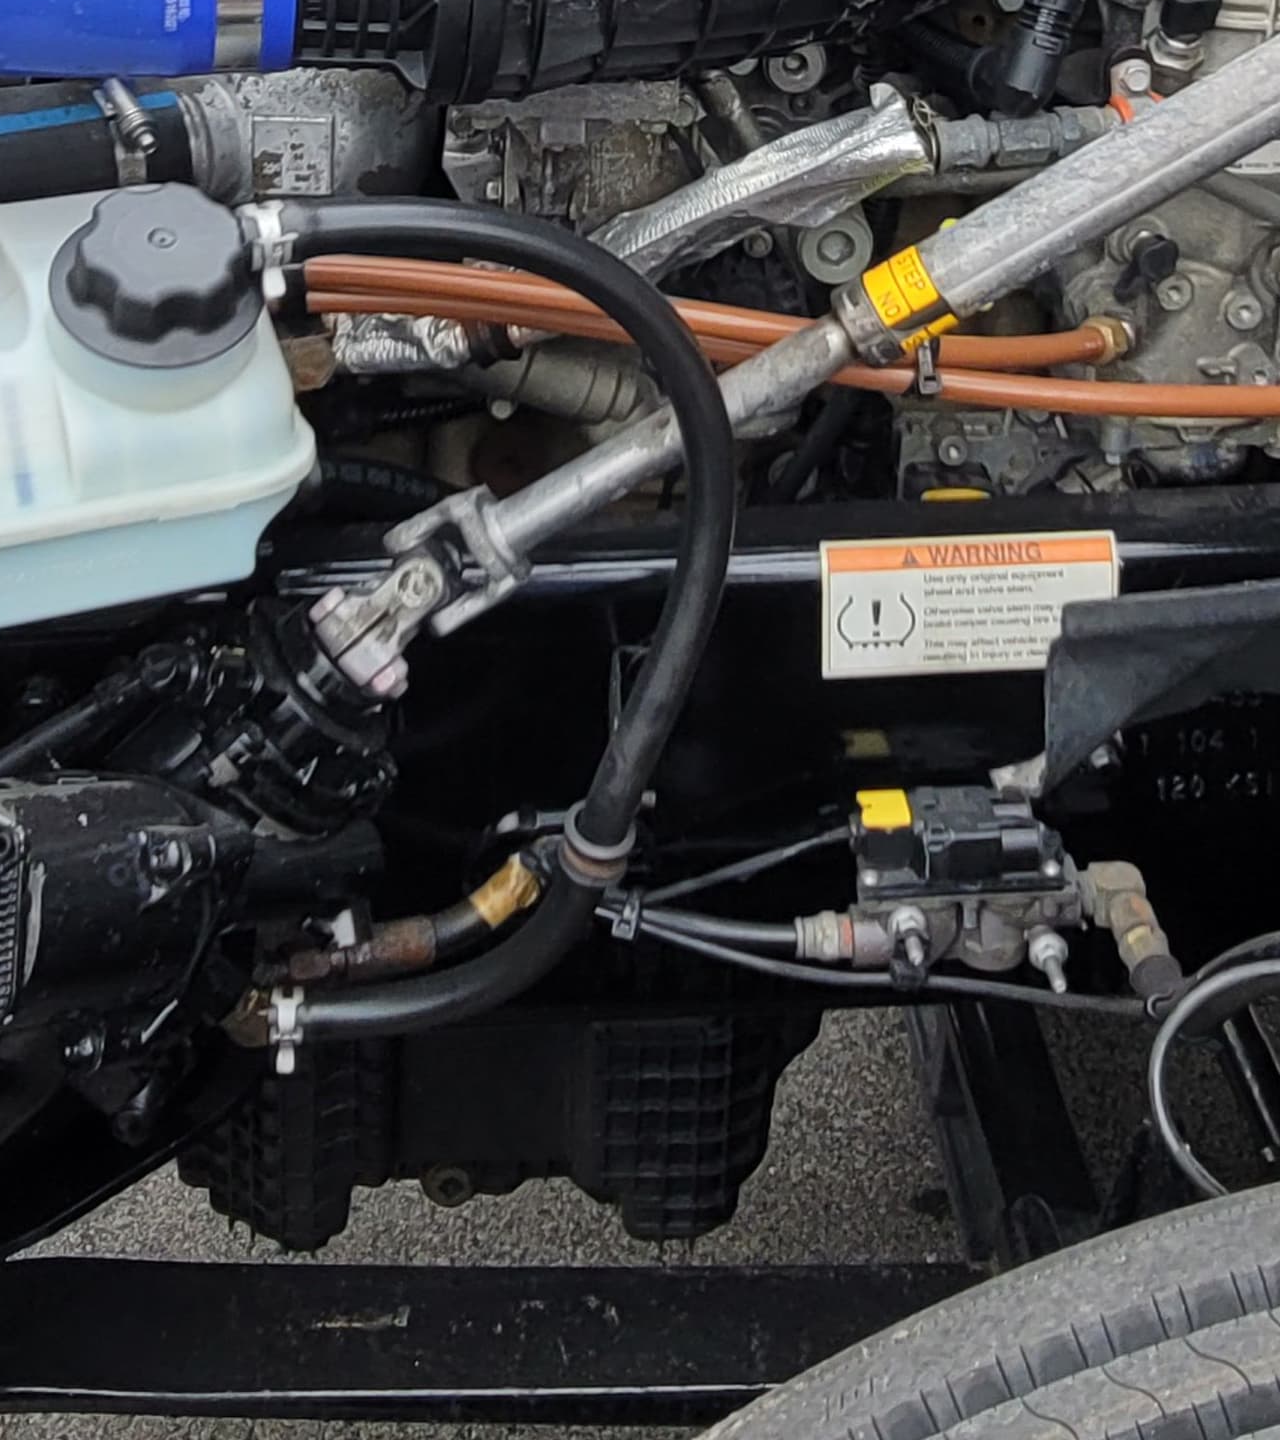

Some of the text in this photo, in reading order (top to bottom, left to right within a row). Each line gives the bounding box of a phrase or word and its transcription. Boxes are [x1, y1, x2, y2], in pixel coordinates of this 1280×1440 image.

[896, 254, 926, 290] STEP
[928, 542, 1043, 566] WARNING
[924, 568, 1064, 584] Use only original equipment
[956, 585, 975, 595] and
[978, 585, 1003, 594] valve
[924, 605, 975, 616] Otherwise
[978, 604, 1003, 614] valve
